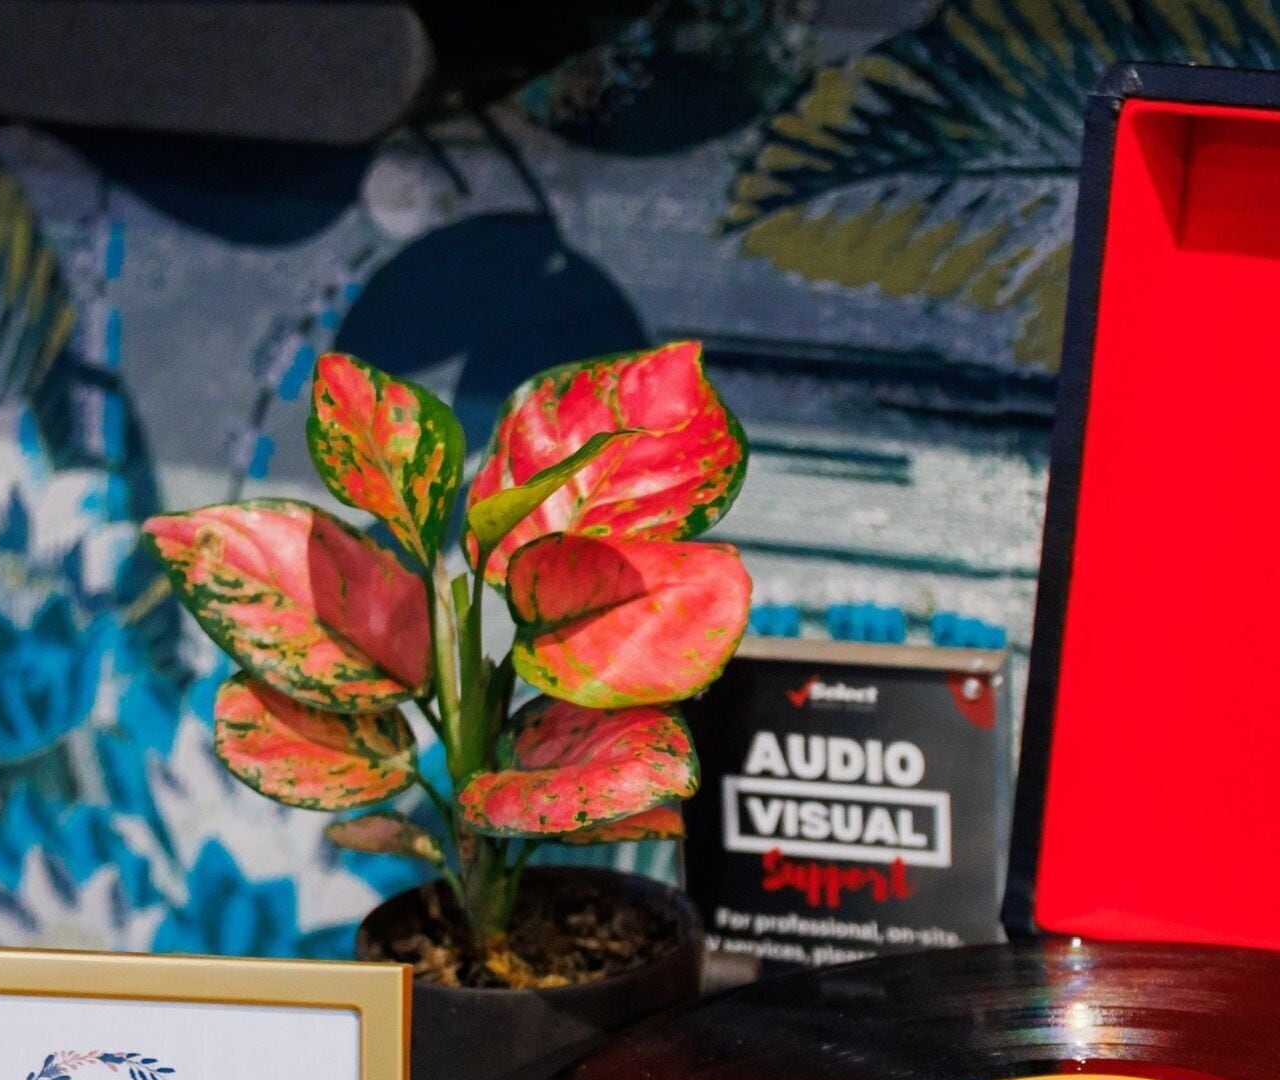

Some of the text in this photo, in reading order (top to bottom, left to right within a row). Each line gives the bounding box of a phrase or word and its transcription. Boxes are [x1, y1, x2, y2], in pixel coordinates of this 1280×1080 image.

[809, 681, 878, 704] Select
[745, 731, 926, 787] AUDIO
[745, 796, 928, 848] VISUAL
[761, 847, 916, 907] Support
[716, 907, 751, 930] For
[753, 913, 884, 944] professional,
